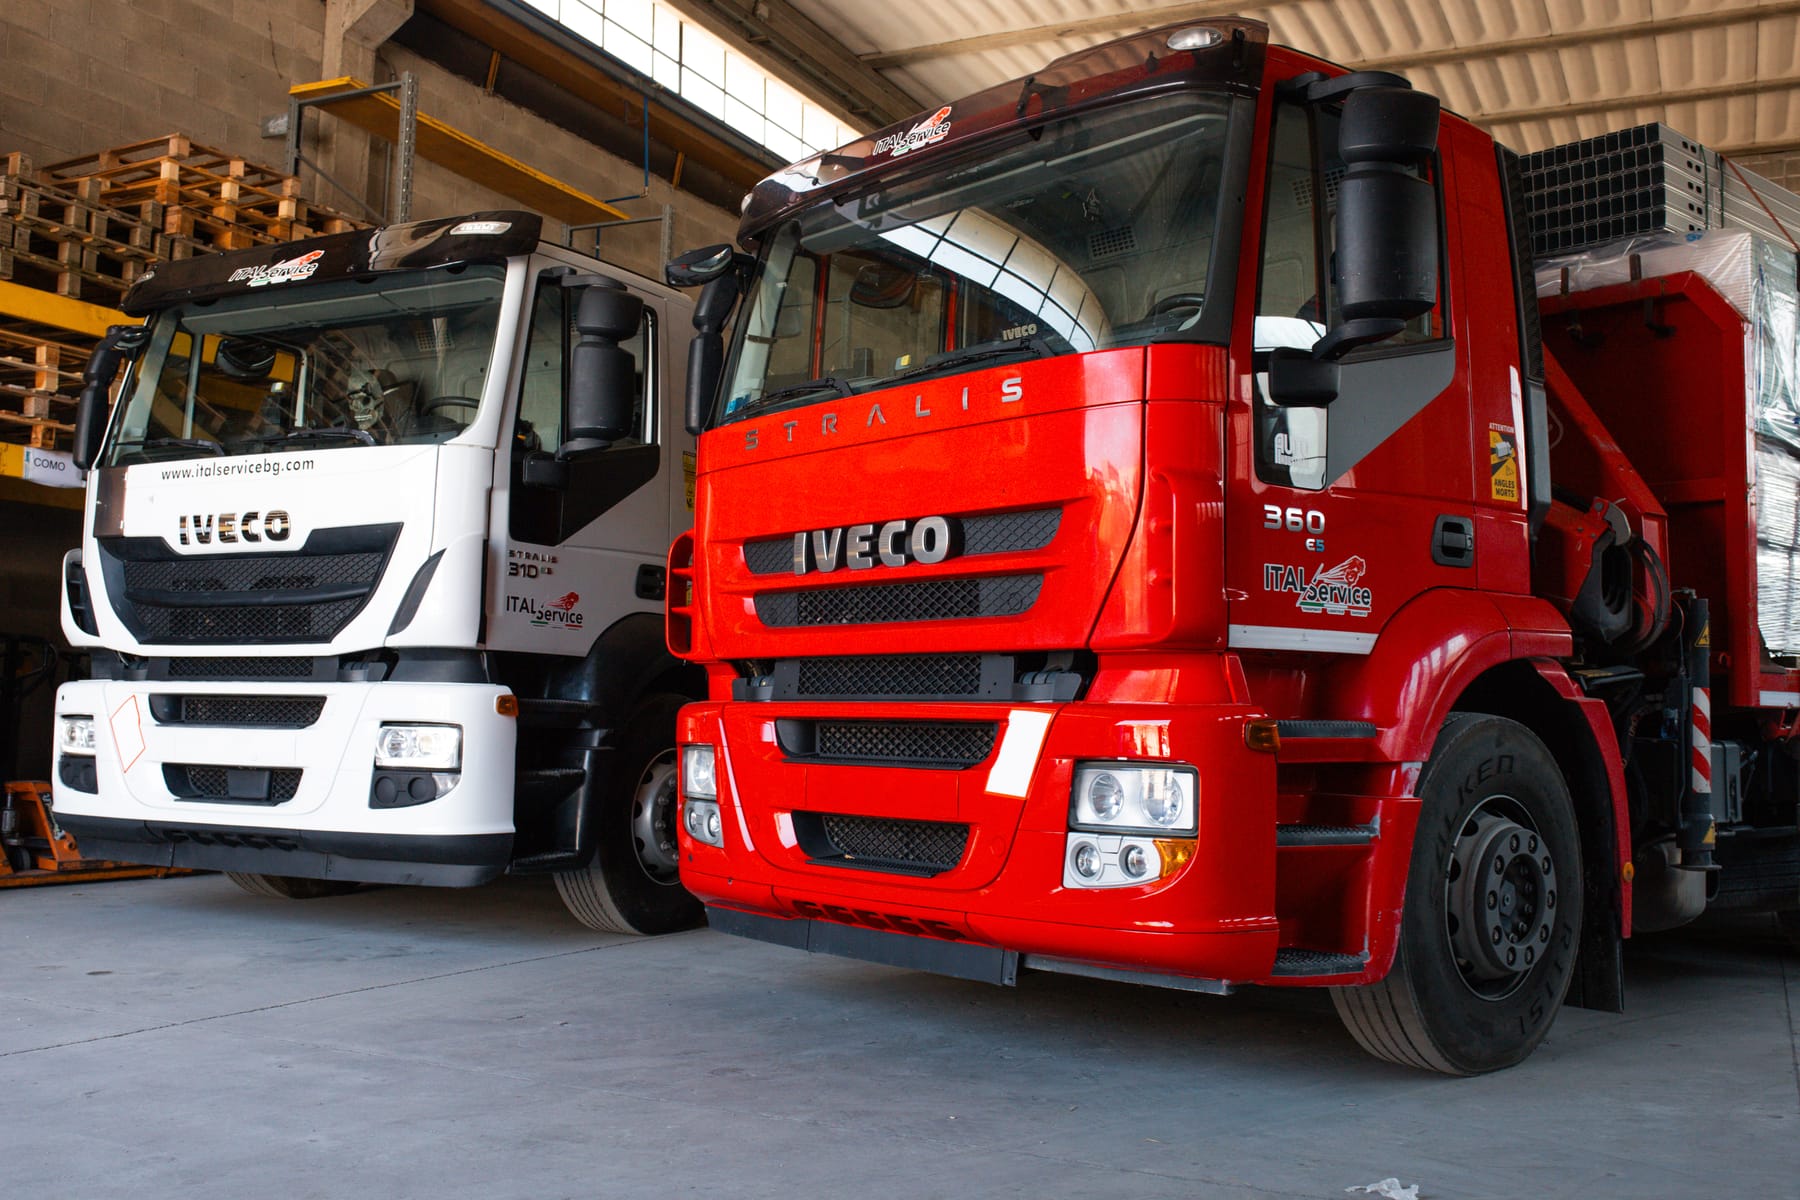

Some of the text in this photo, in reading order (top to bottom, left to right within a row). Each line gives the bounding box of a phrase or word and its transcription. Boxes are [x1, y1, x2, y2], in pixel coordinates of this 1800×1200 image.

[1002, 323, 1038, 341] IVECO
[744, 376, 1024, 450] STRALIS
[33, 457, 66, 472] COMO
[161, 458, 315, 480] www.italservicebg.com
[1494, 478, 1516, 489] ANGLES
[1495, 487, 1516, 498] MORTS
[179, 510, 292, 546] IVECO
[1263, 503, 1326, 535] 360
[793, 515, 950, 577] IVECO
[508, 549, 559, 564] STRALIS
[508, 561, 539, 579] 310
